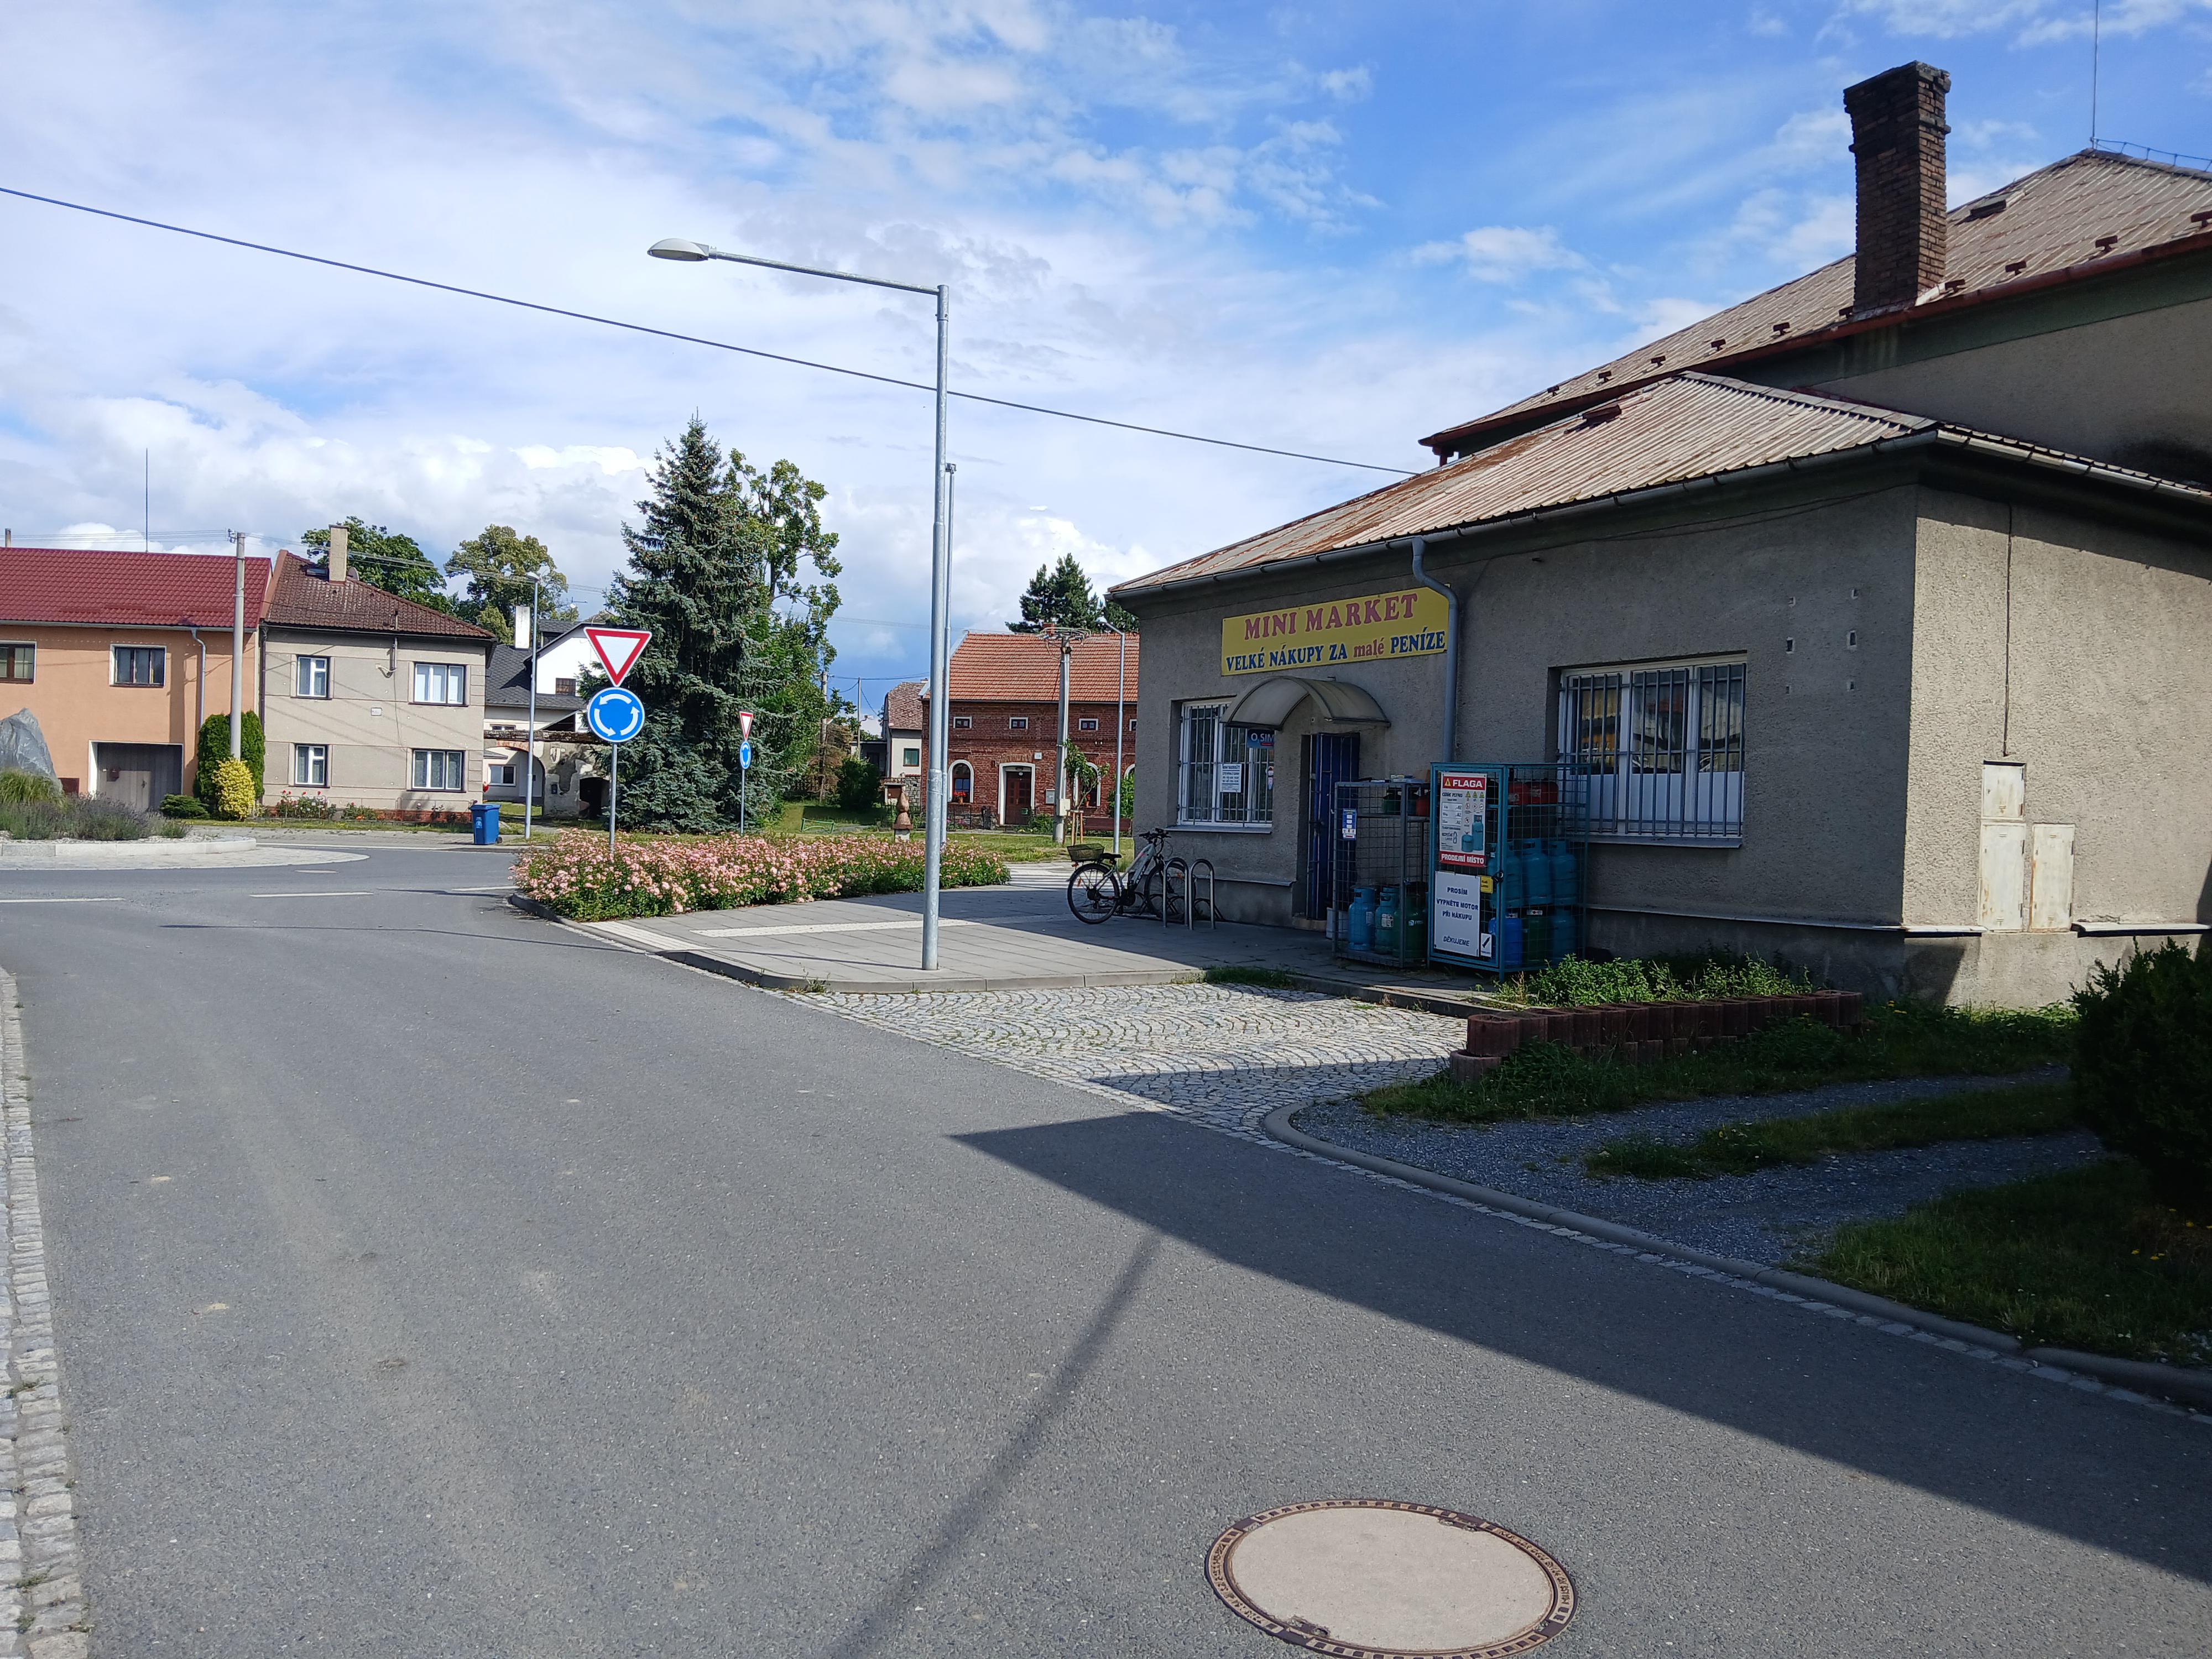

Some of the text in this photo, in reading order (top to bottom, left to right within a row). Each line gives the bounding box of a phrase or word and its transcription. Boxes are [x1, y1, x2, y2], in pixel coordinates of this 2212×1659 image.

[1244, 593, 1418, 640] MINI MARKET
[1226, 627, 1446, 671] VELKÉ NÁKUPY ZA malé PENÍZE
[1441, 853, 1484, 864] PRODEJNÍ MÍSTO
[1436, 898, 1478, 910] VYPNĚTE MOTOR
[1452, 911, 1472, 921] NÁKUPU
[1443, 936, 1469, 946] DĚKUJEME
